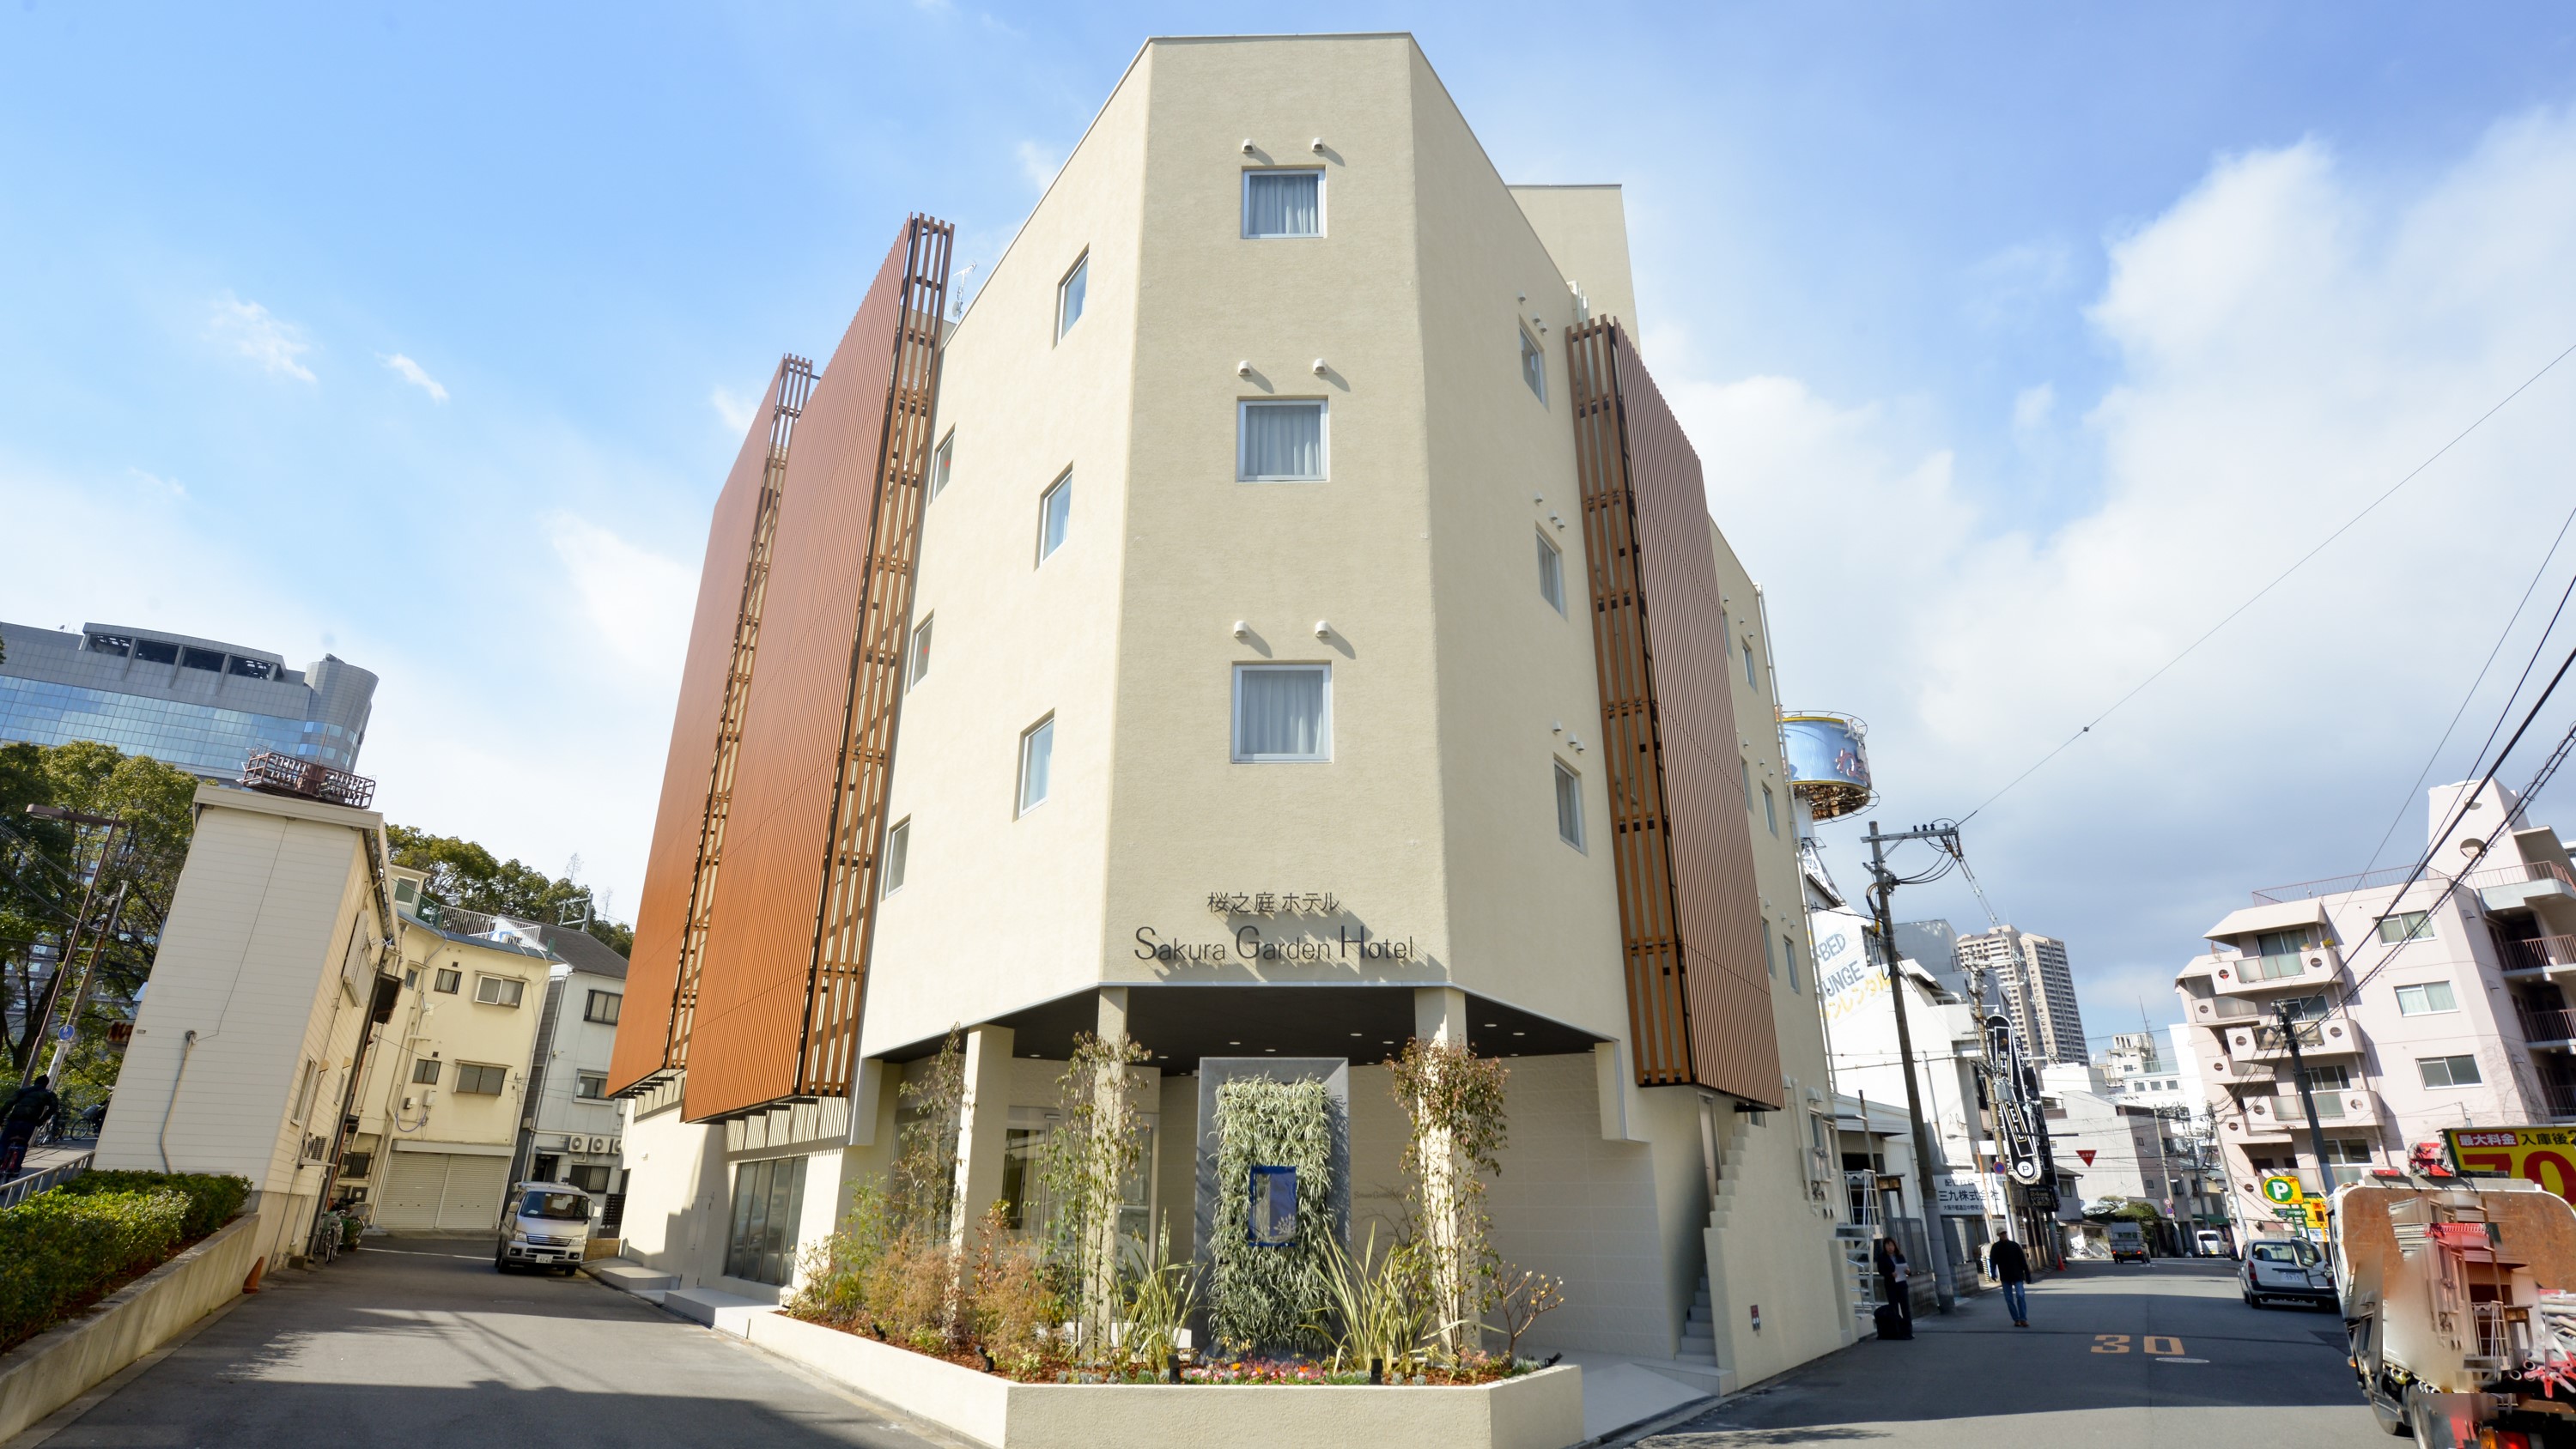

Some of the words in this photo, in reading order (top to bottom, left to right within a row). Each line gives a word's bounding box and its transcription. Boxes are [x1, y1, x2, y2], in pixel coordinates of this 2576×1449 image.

[1133, 926, 1225, 961] Sakura
[1236, 925, 1331, 961] Garden
[1340, 925, 1413, 960] Hotel
[1821, 960, 1865, 997] UNGE
[2458, 1133, 2517, 1147] 最大料金
[2272, 1181, 2288, 1200] P
[2090, 1334, 2185, 1355] 30
